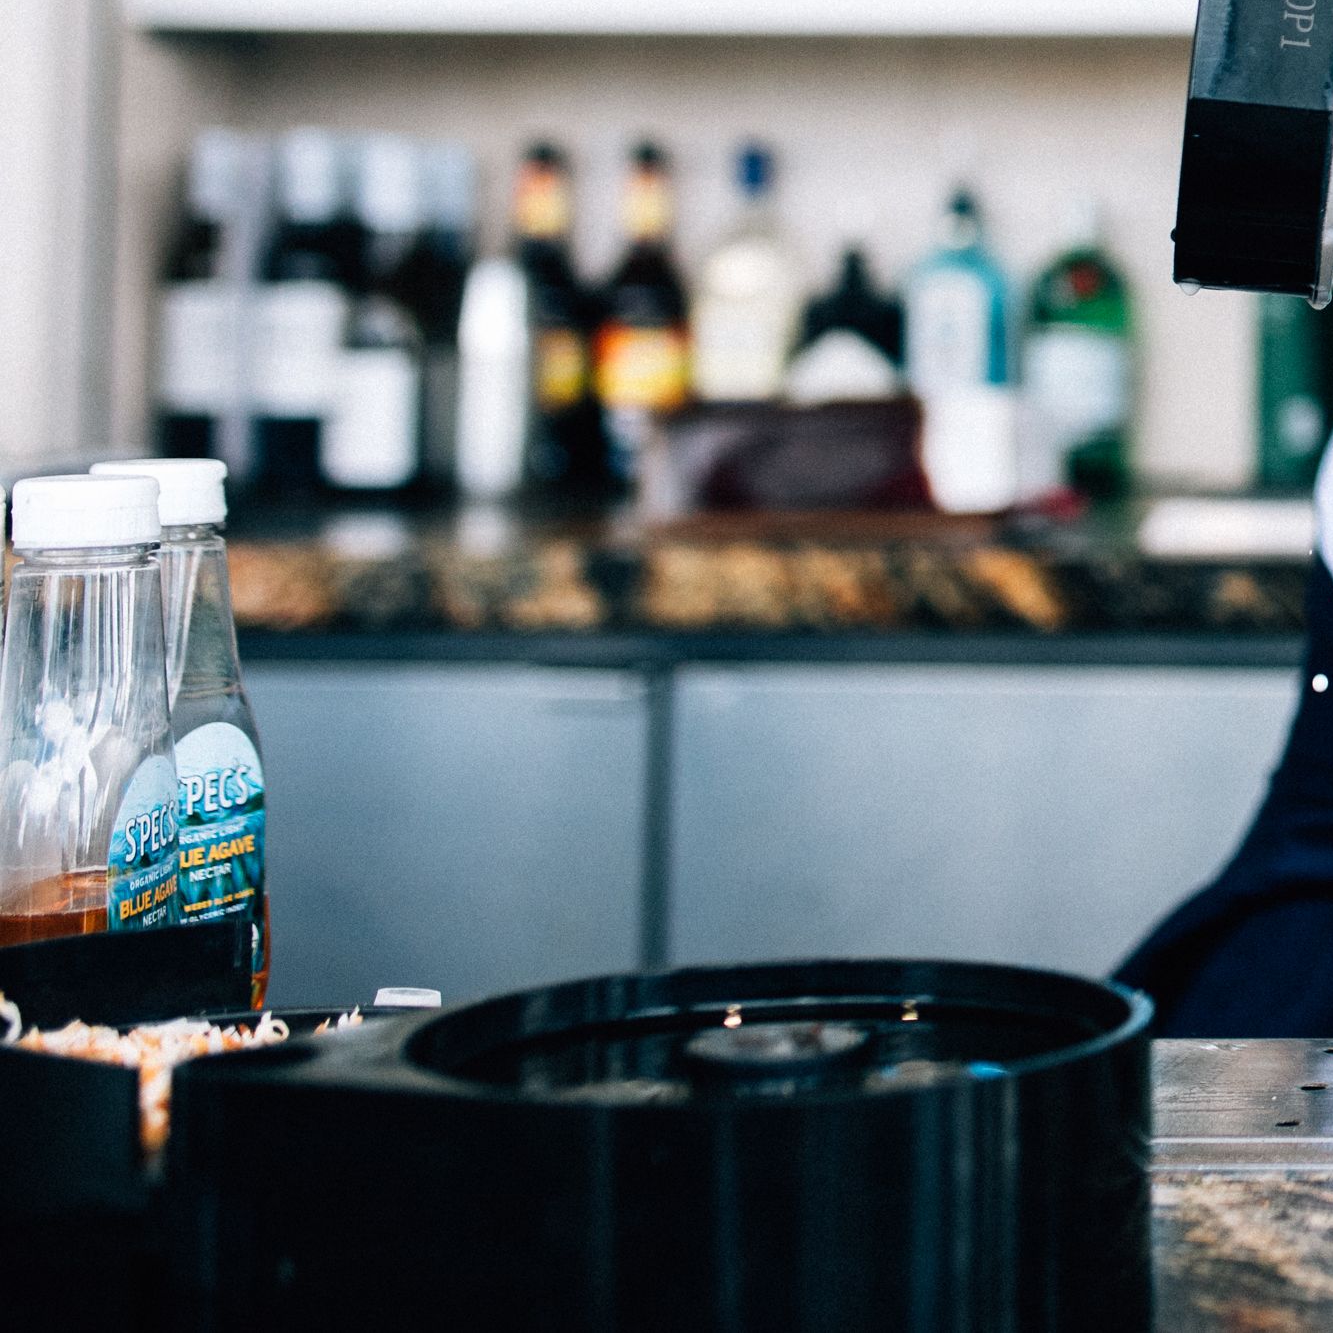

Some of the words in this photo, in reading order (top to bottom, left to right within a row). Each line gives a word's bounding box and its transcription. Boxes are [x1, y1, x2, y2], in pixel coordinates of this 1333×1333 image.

[179, 847, 206, 869] UE
[207, 834, 256, 863] AGAVE
[129, 869, 159, 891] ORGANIC
[189, 863, 232, 882] NECTAR
[119, 890, 152, 920] BLUE
[153, 874, 177, 906] AGAVE
[143, 905, 167, 928] NECTAR
